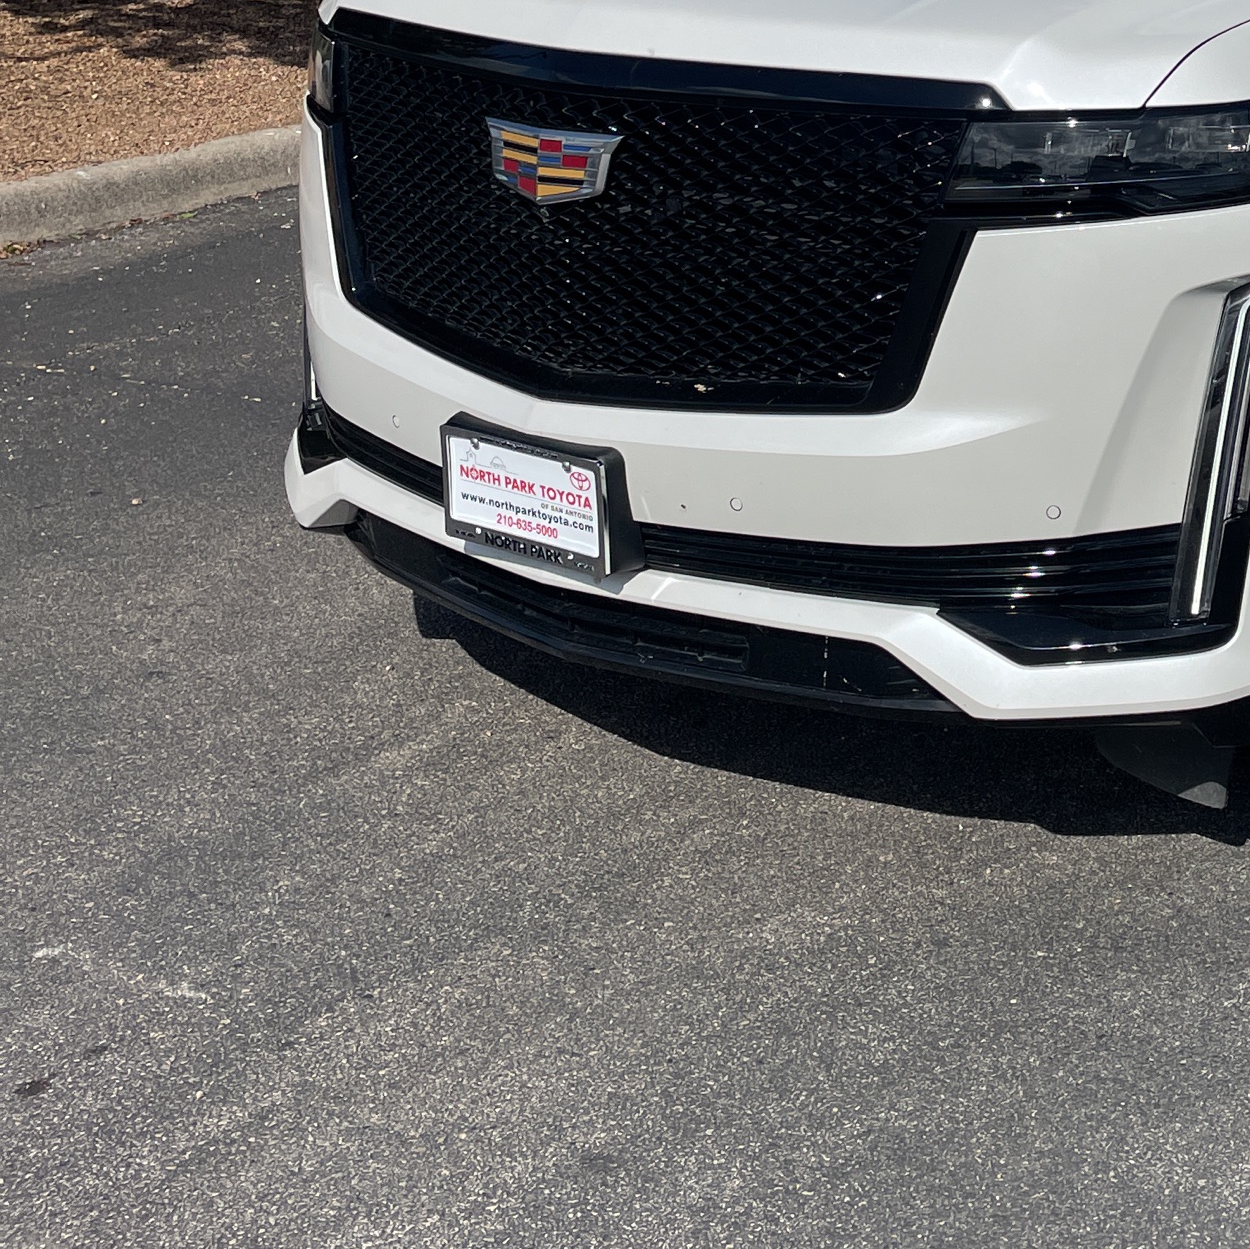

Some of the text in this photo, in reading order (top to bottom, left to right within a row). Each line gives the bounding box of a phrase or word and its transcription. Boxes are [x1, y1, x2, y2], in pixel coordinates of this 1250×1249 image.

[460, 464, 593, 510] NORTH PARK TOYOTA
[461, 492, 594, 533] www.northparktoyota.com
[551, 505, 564, 513] SAN
[496, 513, 558, 539] 210-635-5000
[484, 532, 527, 554] NORTH
[530, 544, 563, 565] PARK
